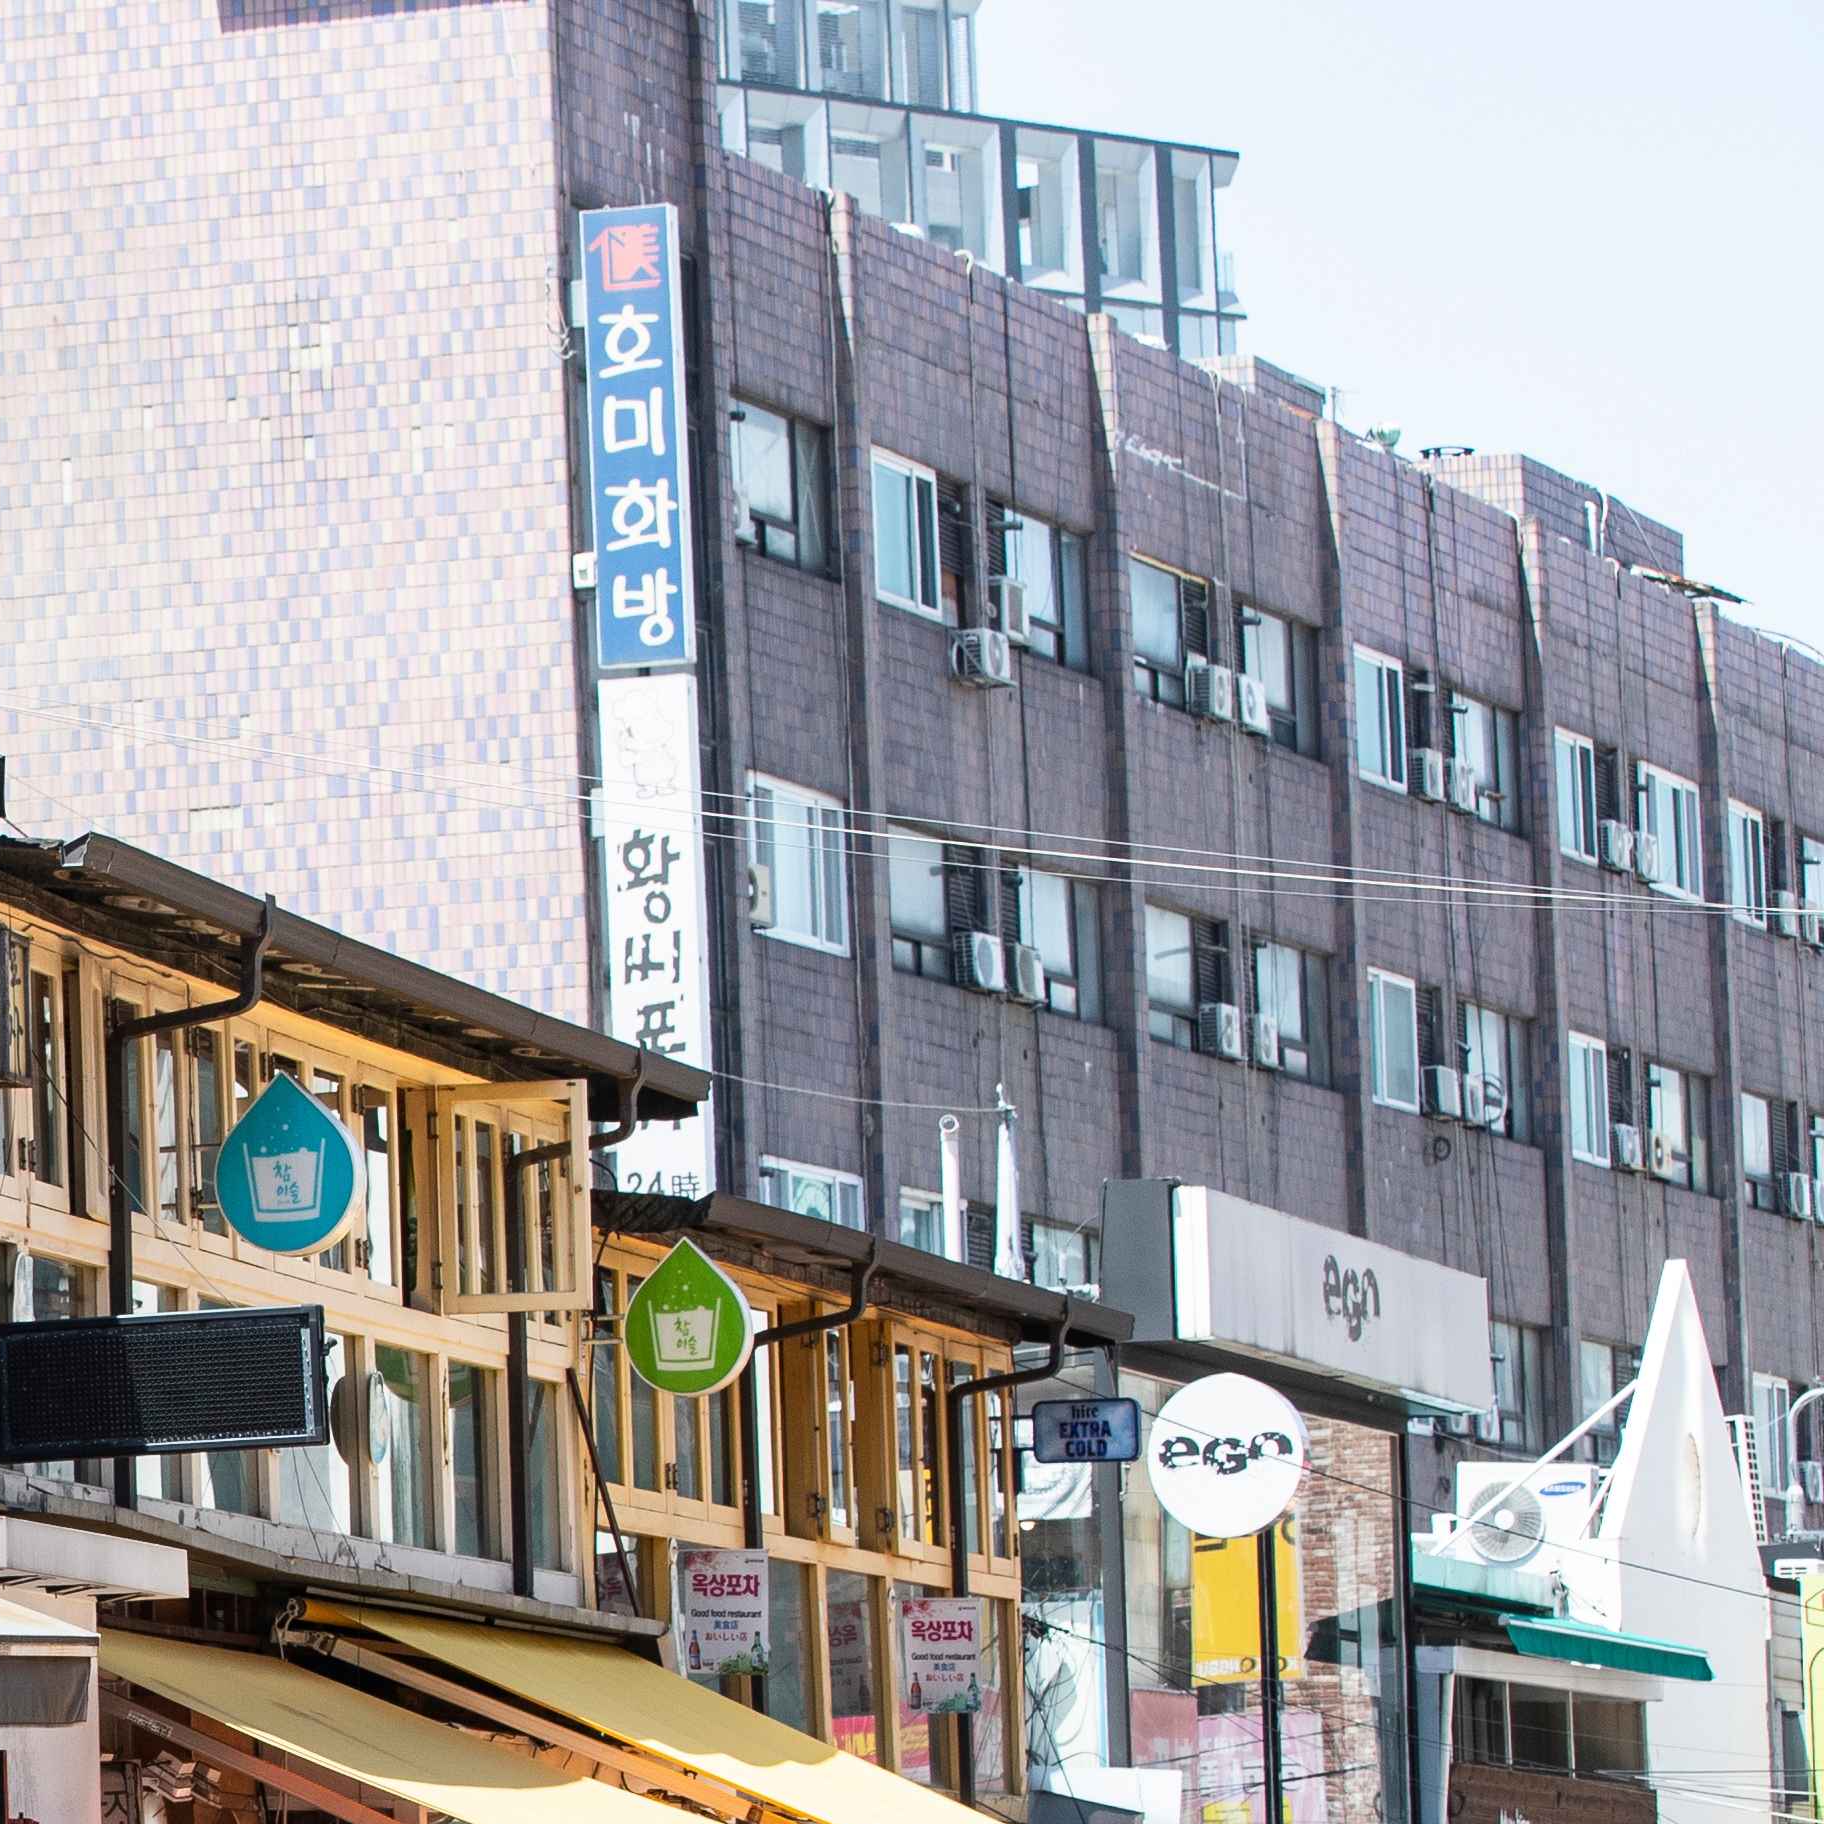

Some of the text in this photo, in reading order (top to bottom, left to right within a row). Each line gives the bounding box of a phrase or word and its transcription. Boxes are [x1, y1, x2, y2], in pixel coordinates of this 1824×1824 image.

[598, 302, 678, 648] 호미화방
[1059, 1420, 1113, 1438] EXTRA
[1064, 1439, 1109, 1458] COLD
[691, 1573, 760, 1598] 옥상포차
[690, 1608, 762, 1618] Good food restaurant
[911, 1620, 974, 1642] 옥상포차
[911, 1652, 929, 1661] Good
[944, 1652, 977, 1661] restaurant
